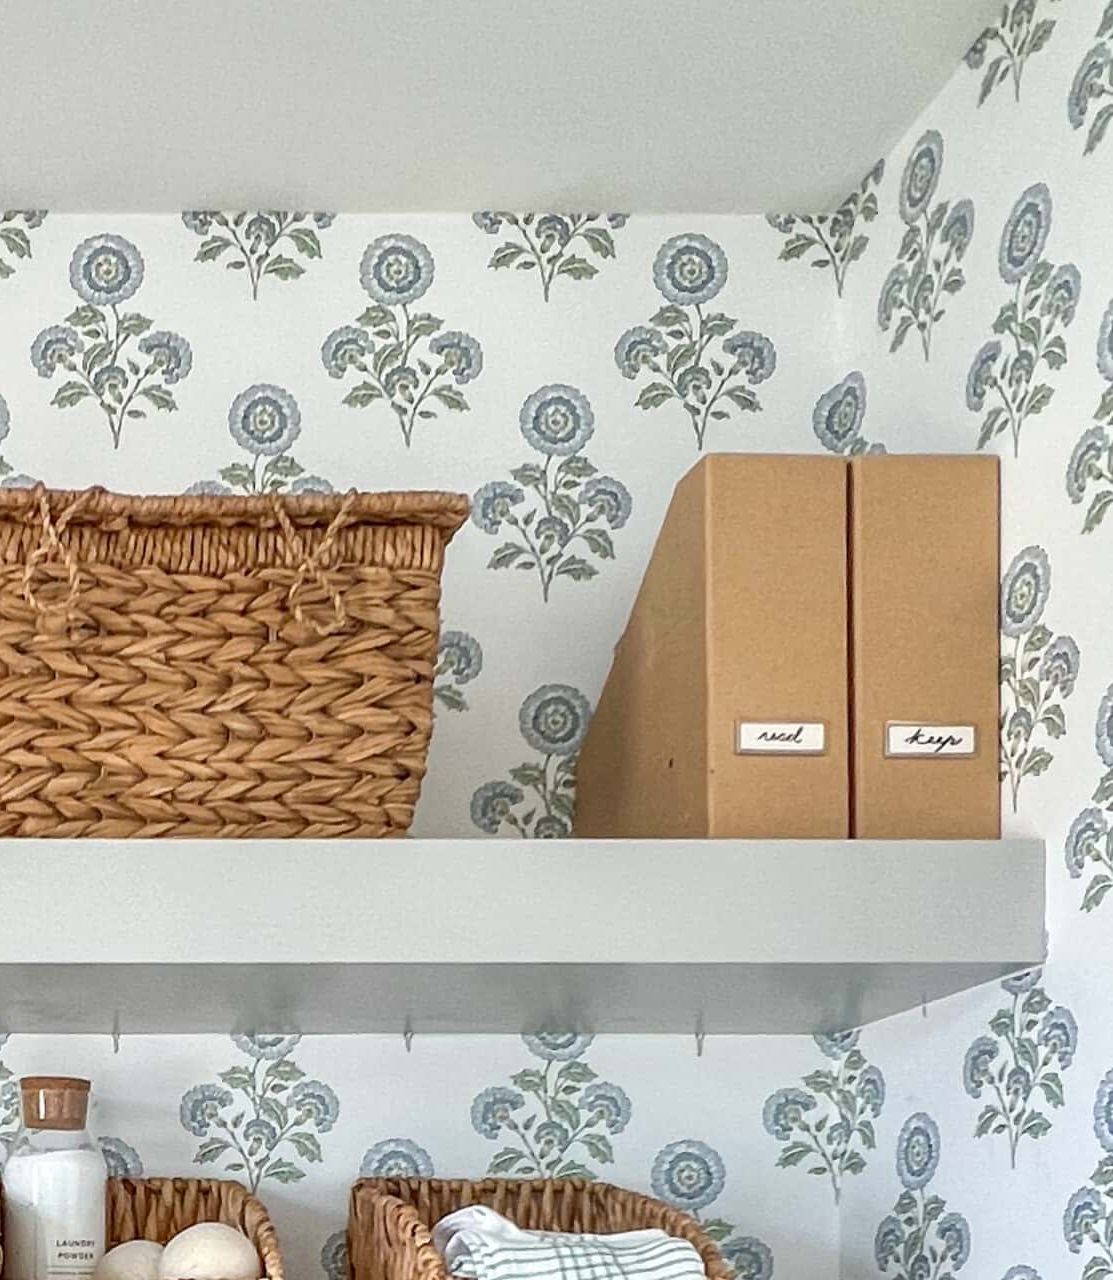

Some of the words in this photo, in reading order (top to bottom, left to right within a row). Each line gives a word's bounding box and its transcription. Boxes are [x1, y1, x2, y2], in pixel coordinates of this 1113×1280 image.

[904, 728, 964, 753] keep
[55, 1239, 96, 1248] LAUNDRY
[57, 1252, 94, 1260] POWDER
